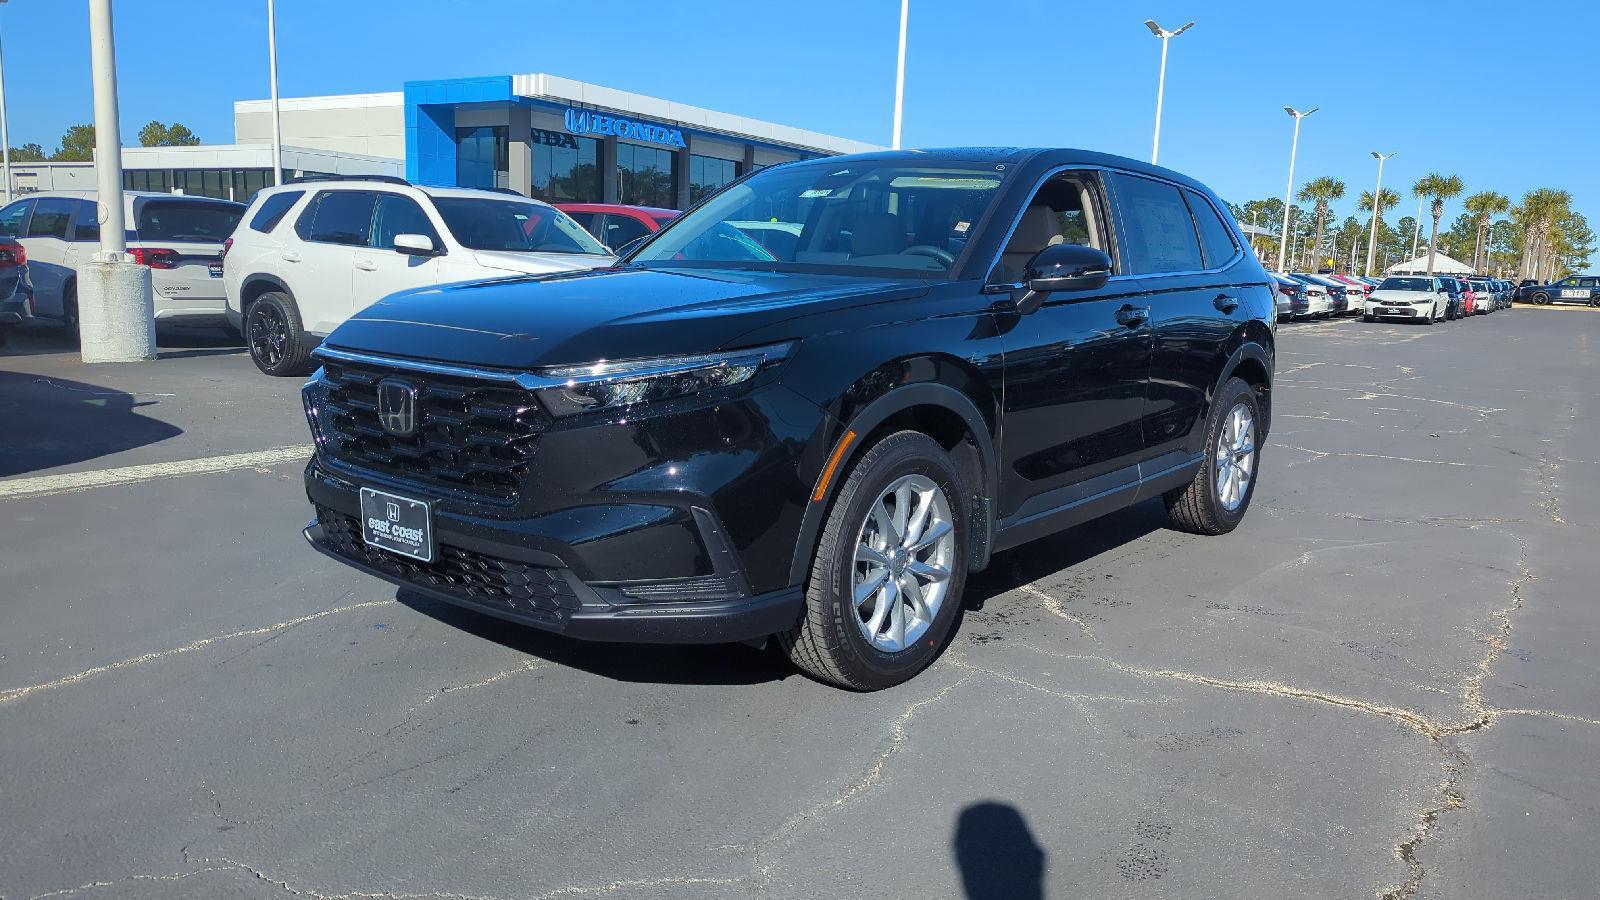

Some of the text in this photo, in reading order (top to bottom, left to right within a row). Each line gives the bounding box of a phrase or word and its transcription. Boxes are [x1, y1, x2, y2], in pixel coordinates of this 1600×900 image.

[592, 114, 687, 148] HONDA
[368, 517, 390, 534] east
[392, 525, 424, 543] coast
